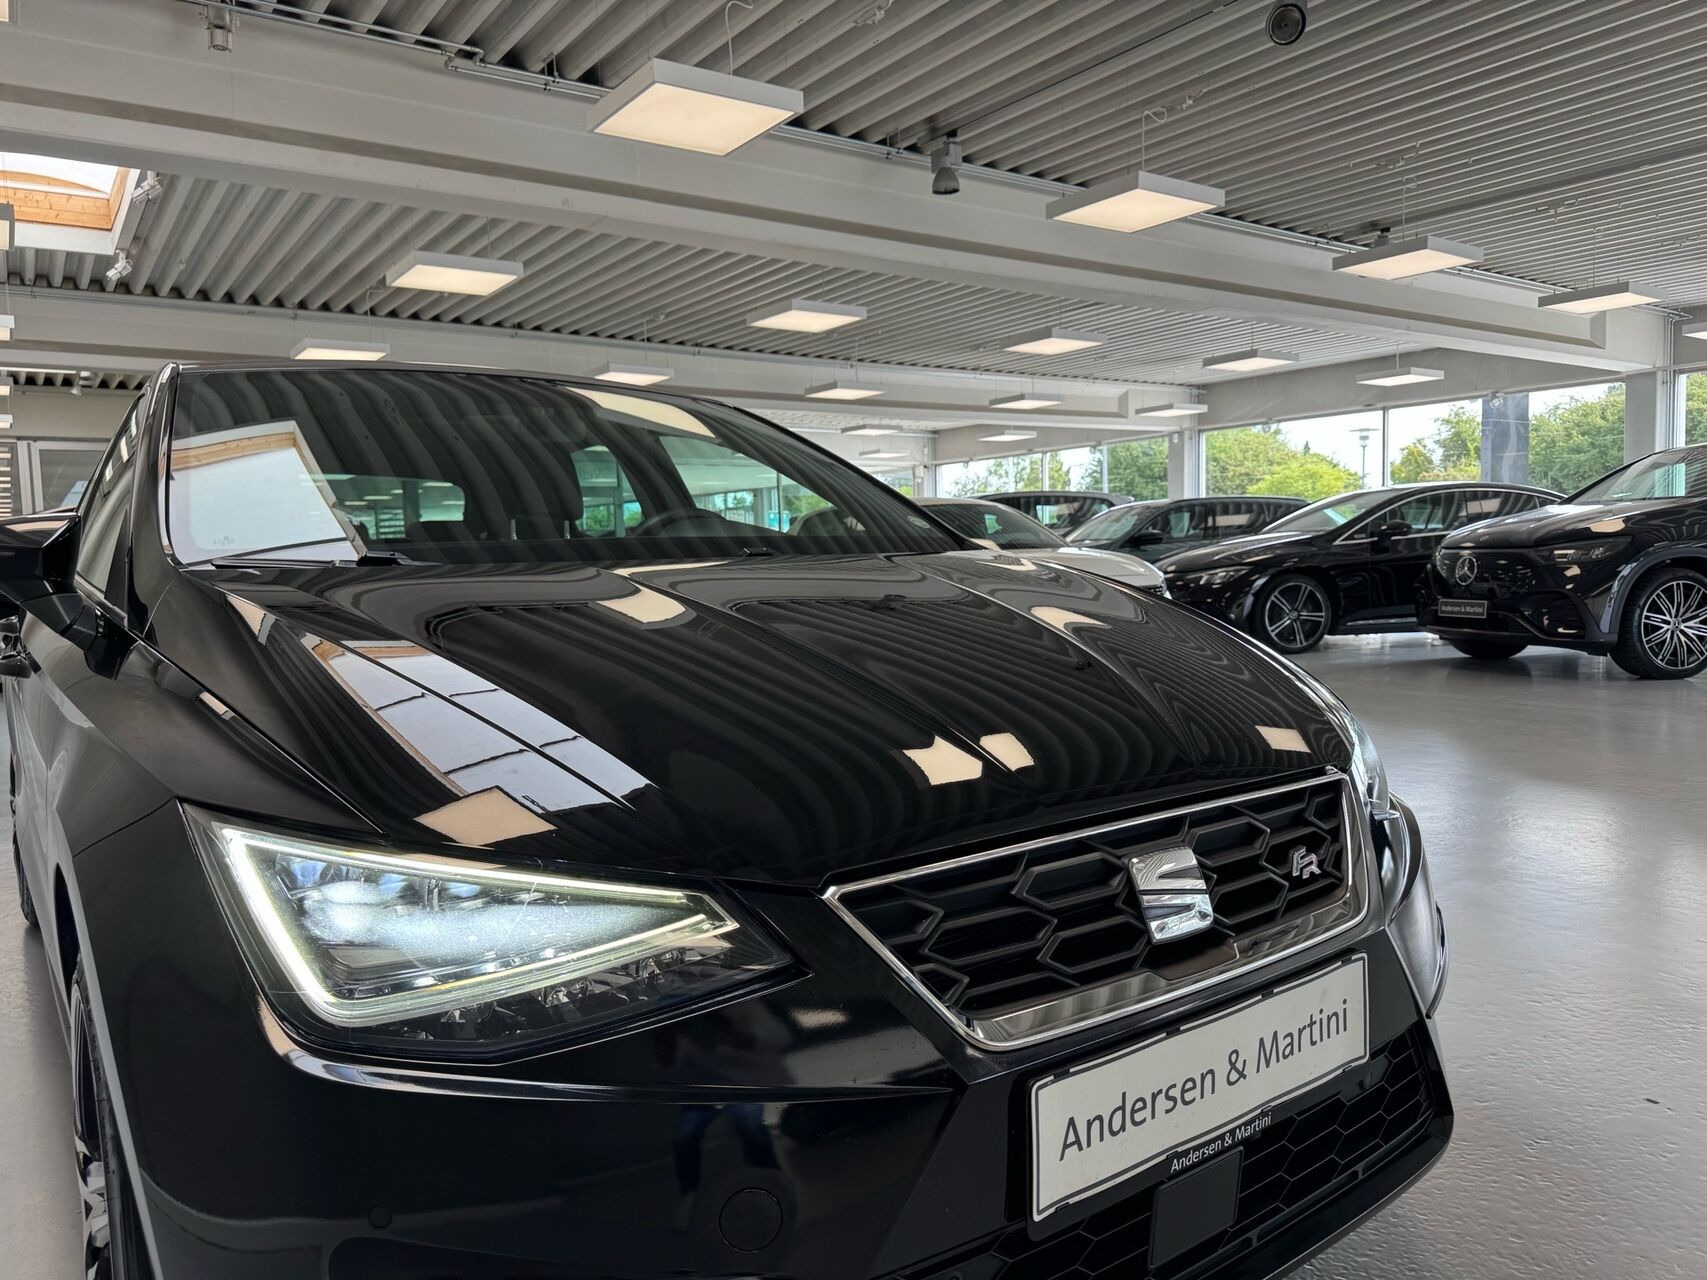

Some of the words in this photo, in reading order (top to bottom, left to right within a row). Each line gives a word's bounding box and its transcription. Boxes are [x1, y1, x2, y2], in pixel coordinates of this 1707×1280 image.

[1059, 1068, 1216, 1162] Andersen
[1226, 1049, 1247, 1087] &
[1256, 998, 1348, 1074] Martini
[1170, 1140, 1222, 1174] Andersen
[1224, 1132, 1233, 1147] &
[1235, 1112, 1272, 1142] Martini
